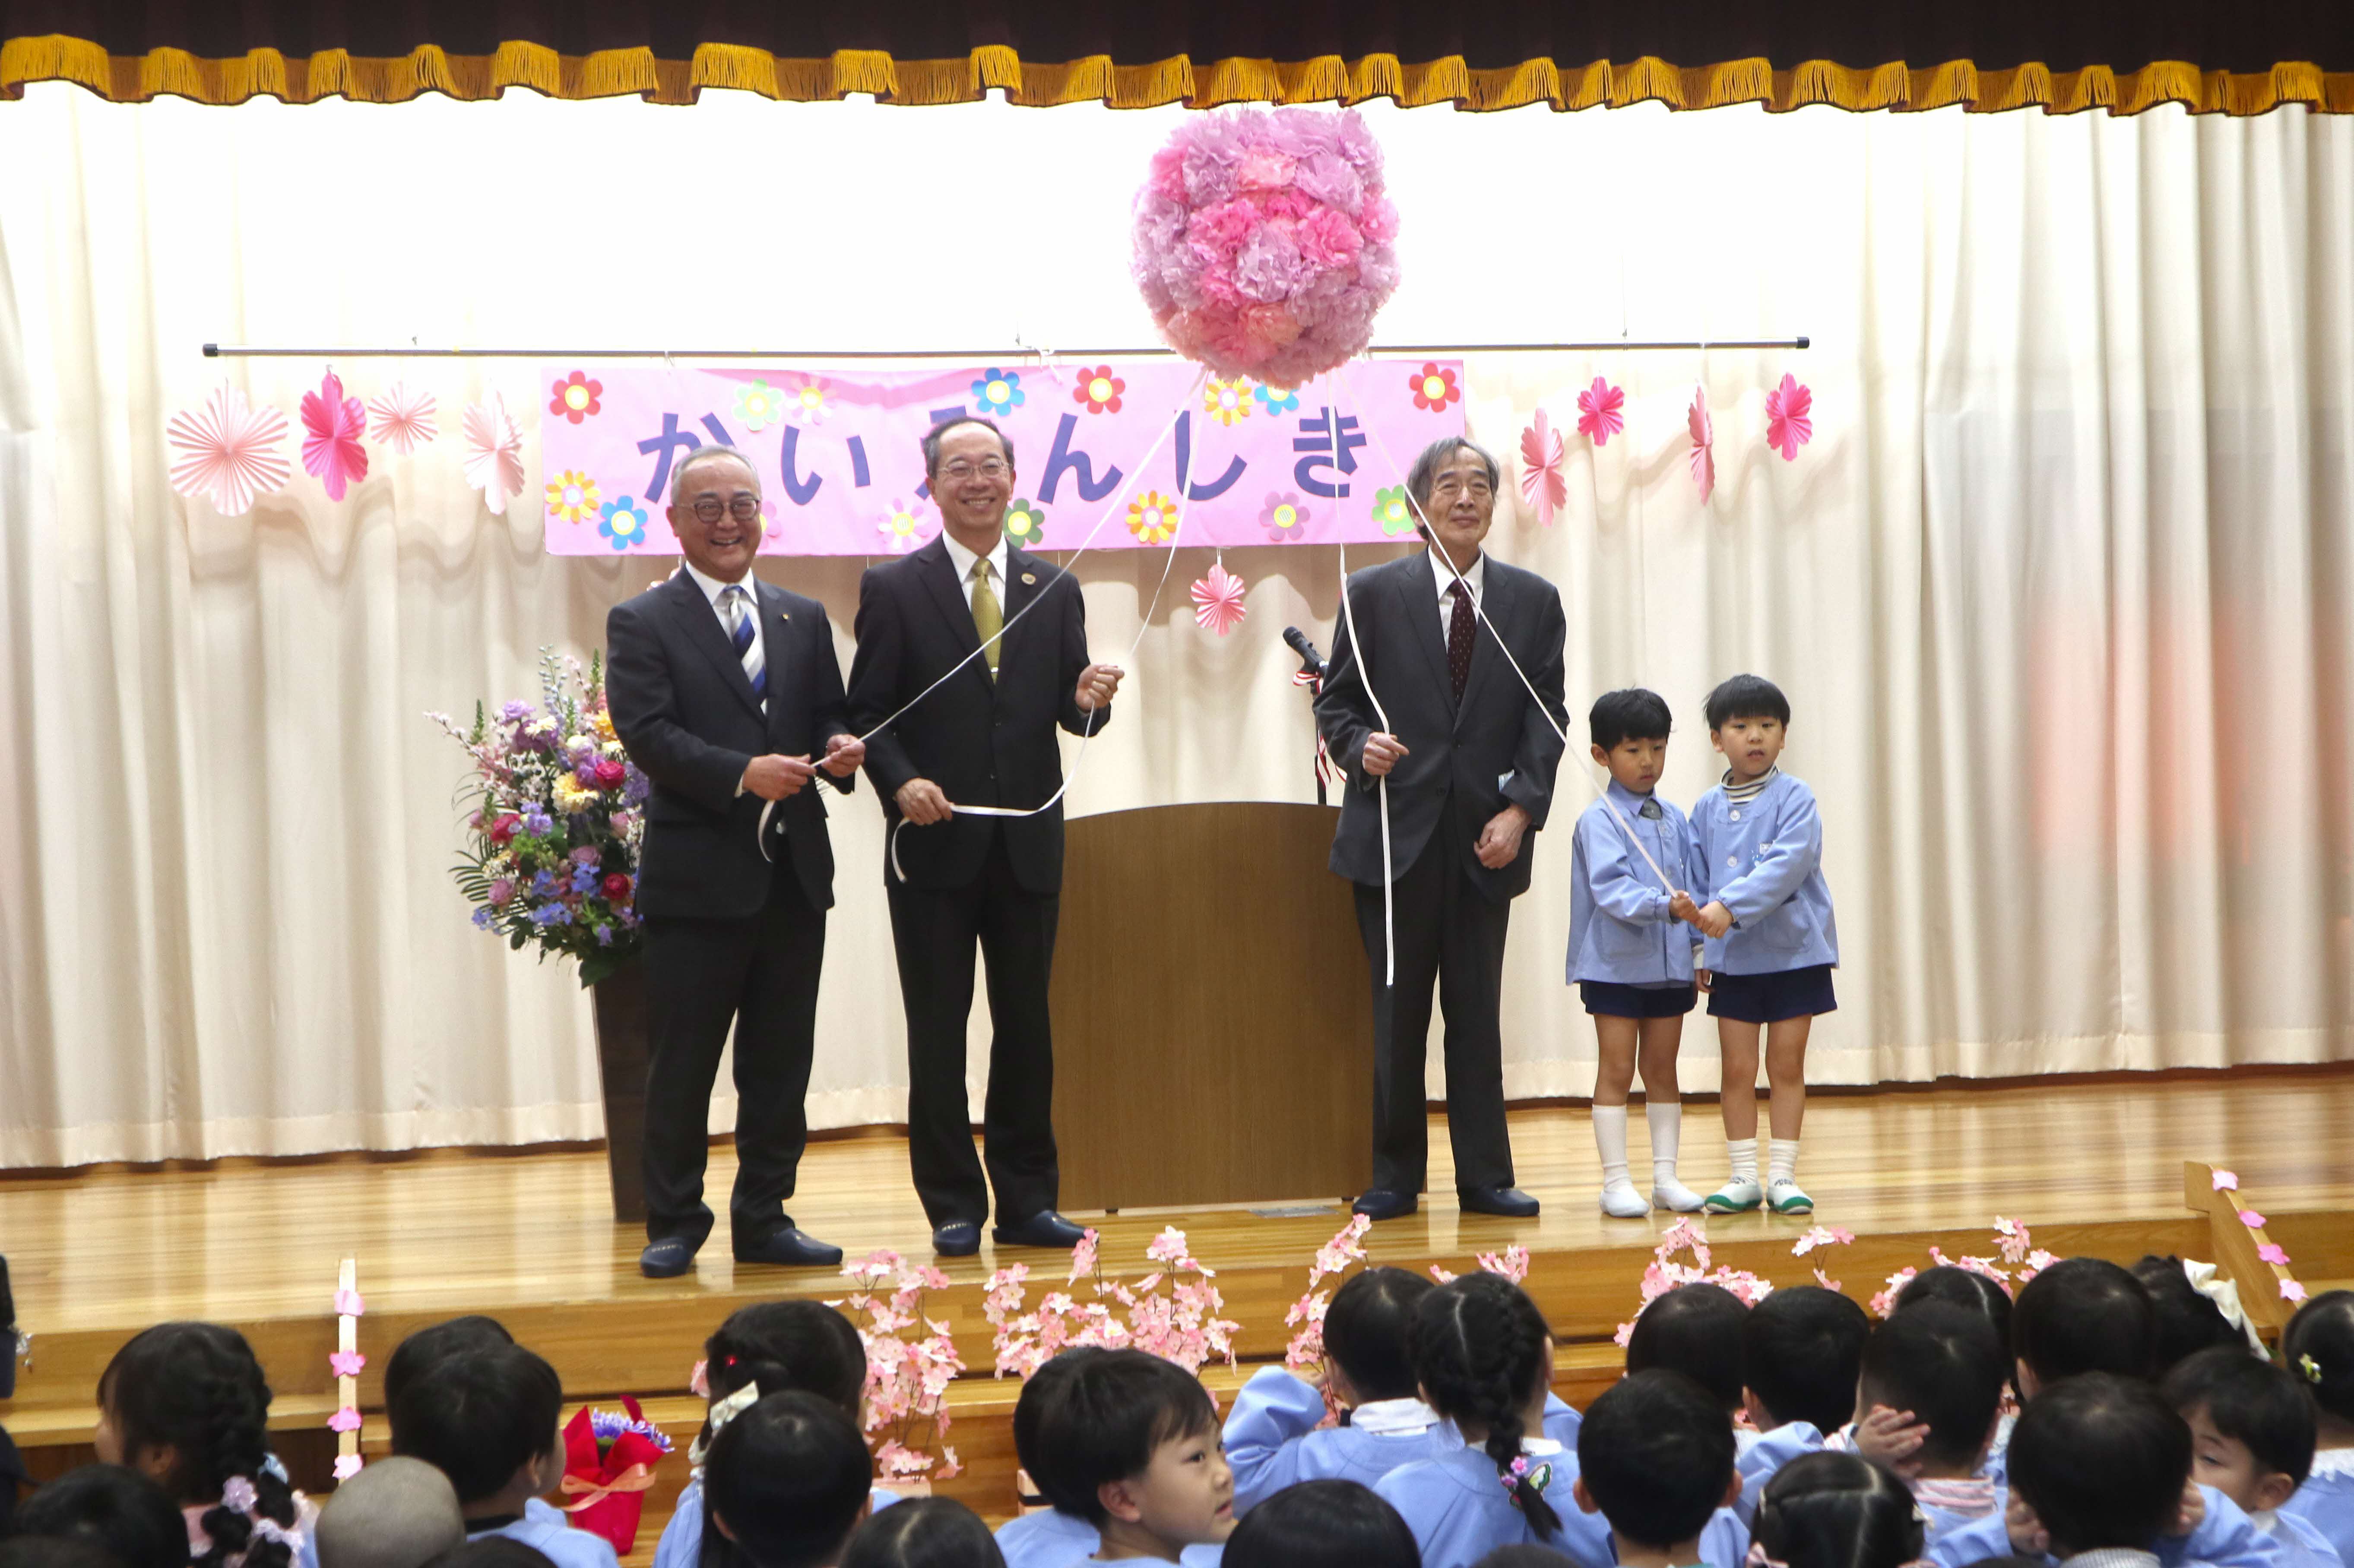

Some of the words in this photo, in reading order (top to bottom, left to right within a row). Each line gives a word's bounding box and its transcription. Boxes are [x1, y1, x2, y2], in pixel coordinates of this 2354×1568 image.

[637, 405, 1367, 505] かいんしき
